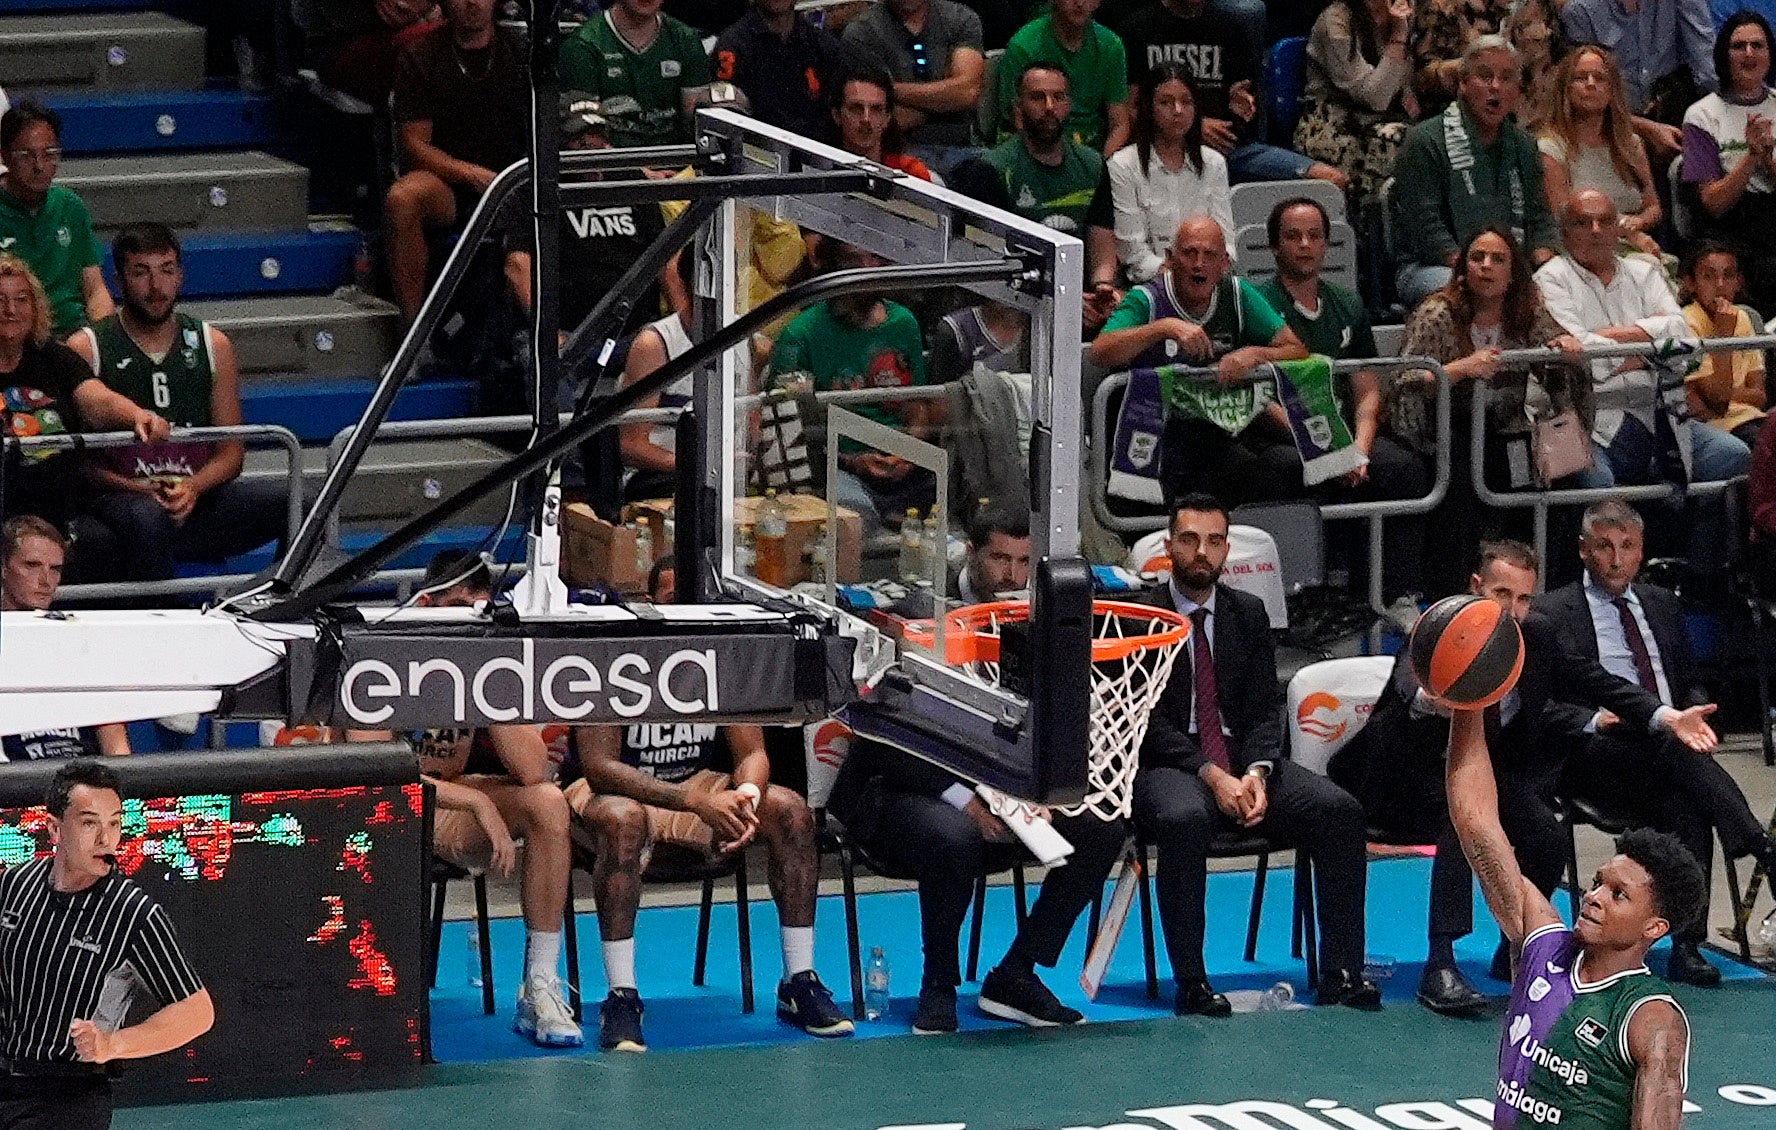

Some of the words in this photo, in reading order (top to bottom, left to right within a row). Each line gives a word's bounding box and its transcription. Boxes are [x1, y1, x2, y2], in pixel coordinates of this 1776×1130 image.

[566, 206, 636, 238] VANS
[152, 371, 171, 408] 6
[341, 637, 719, 724] endesa
[1520, 1035, 1588, 1086] Unicaja
